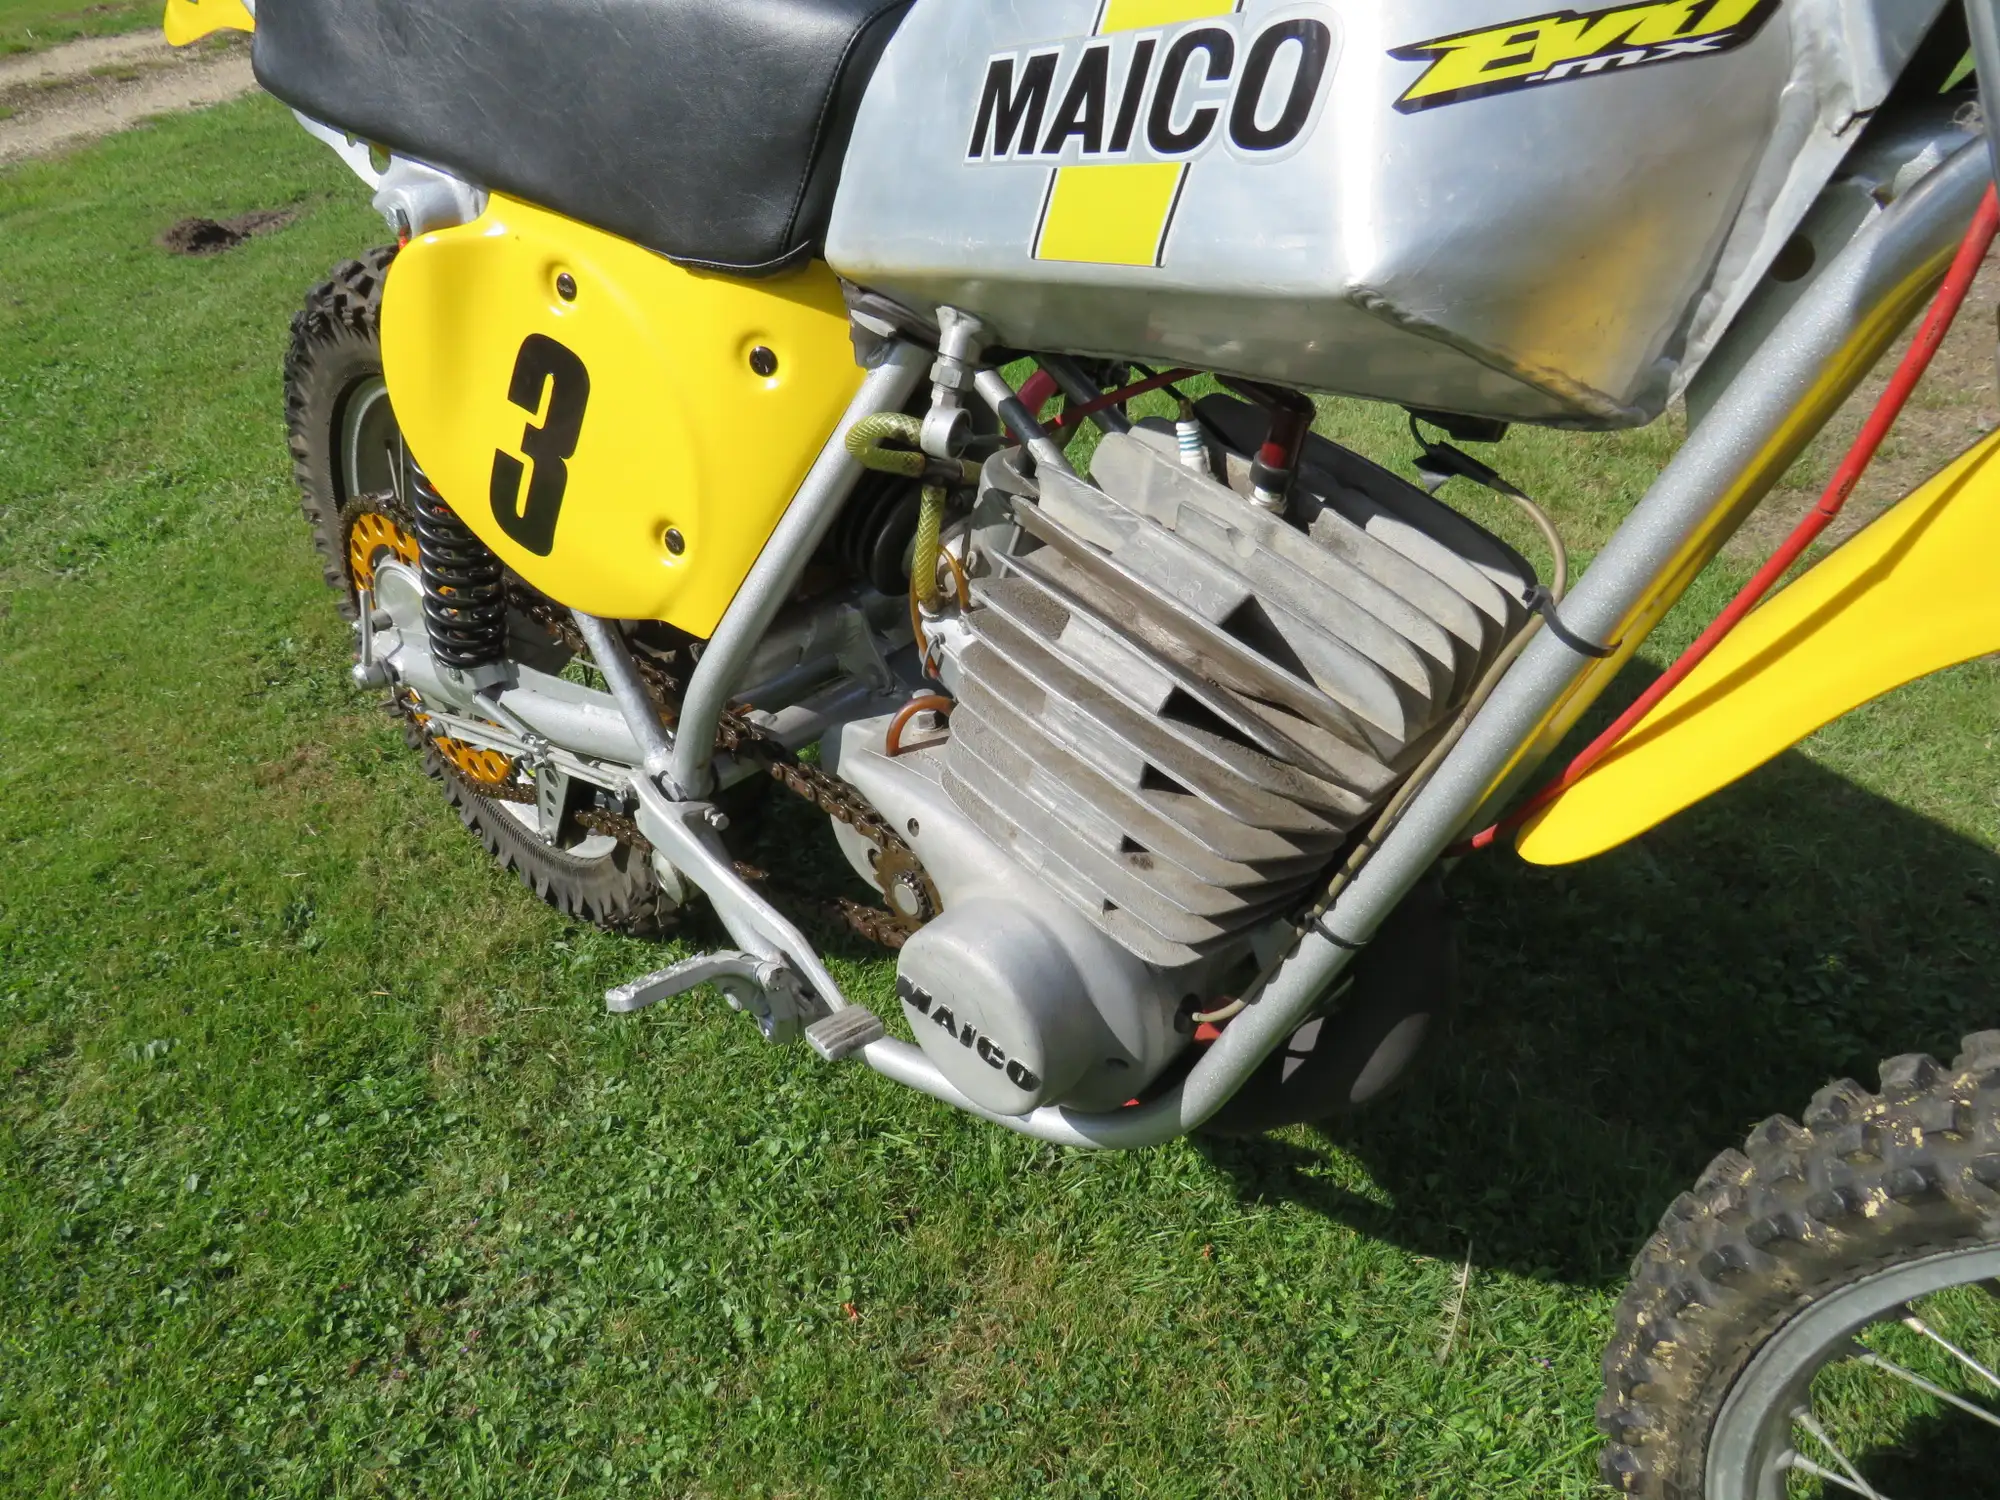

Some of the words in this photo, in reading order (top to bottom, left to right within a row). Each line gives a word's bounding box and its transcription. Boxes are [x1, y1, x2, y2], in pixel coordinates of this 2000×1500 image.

[968, 18, 1332, 158] MAICO
[489, 333, 591, 557] 3
[896, 975, 1042, 1092] MAICO
